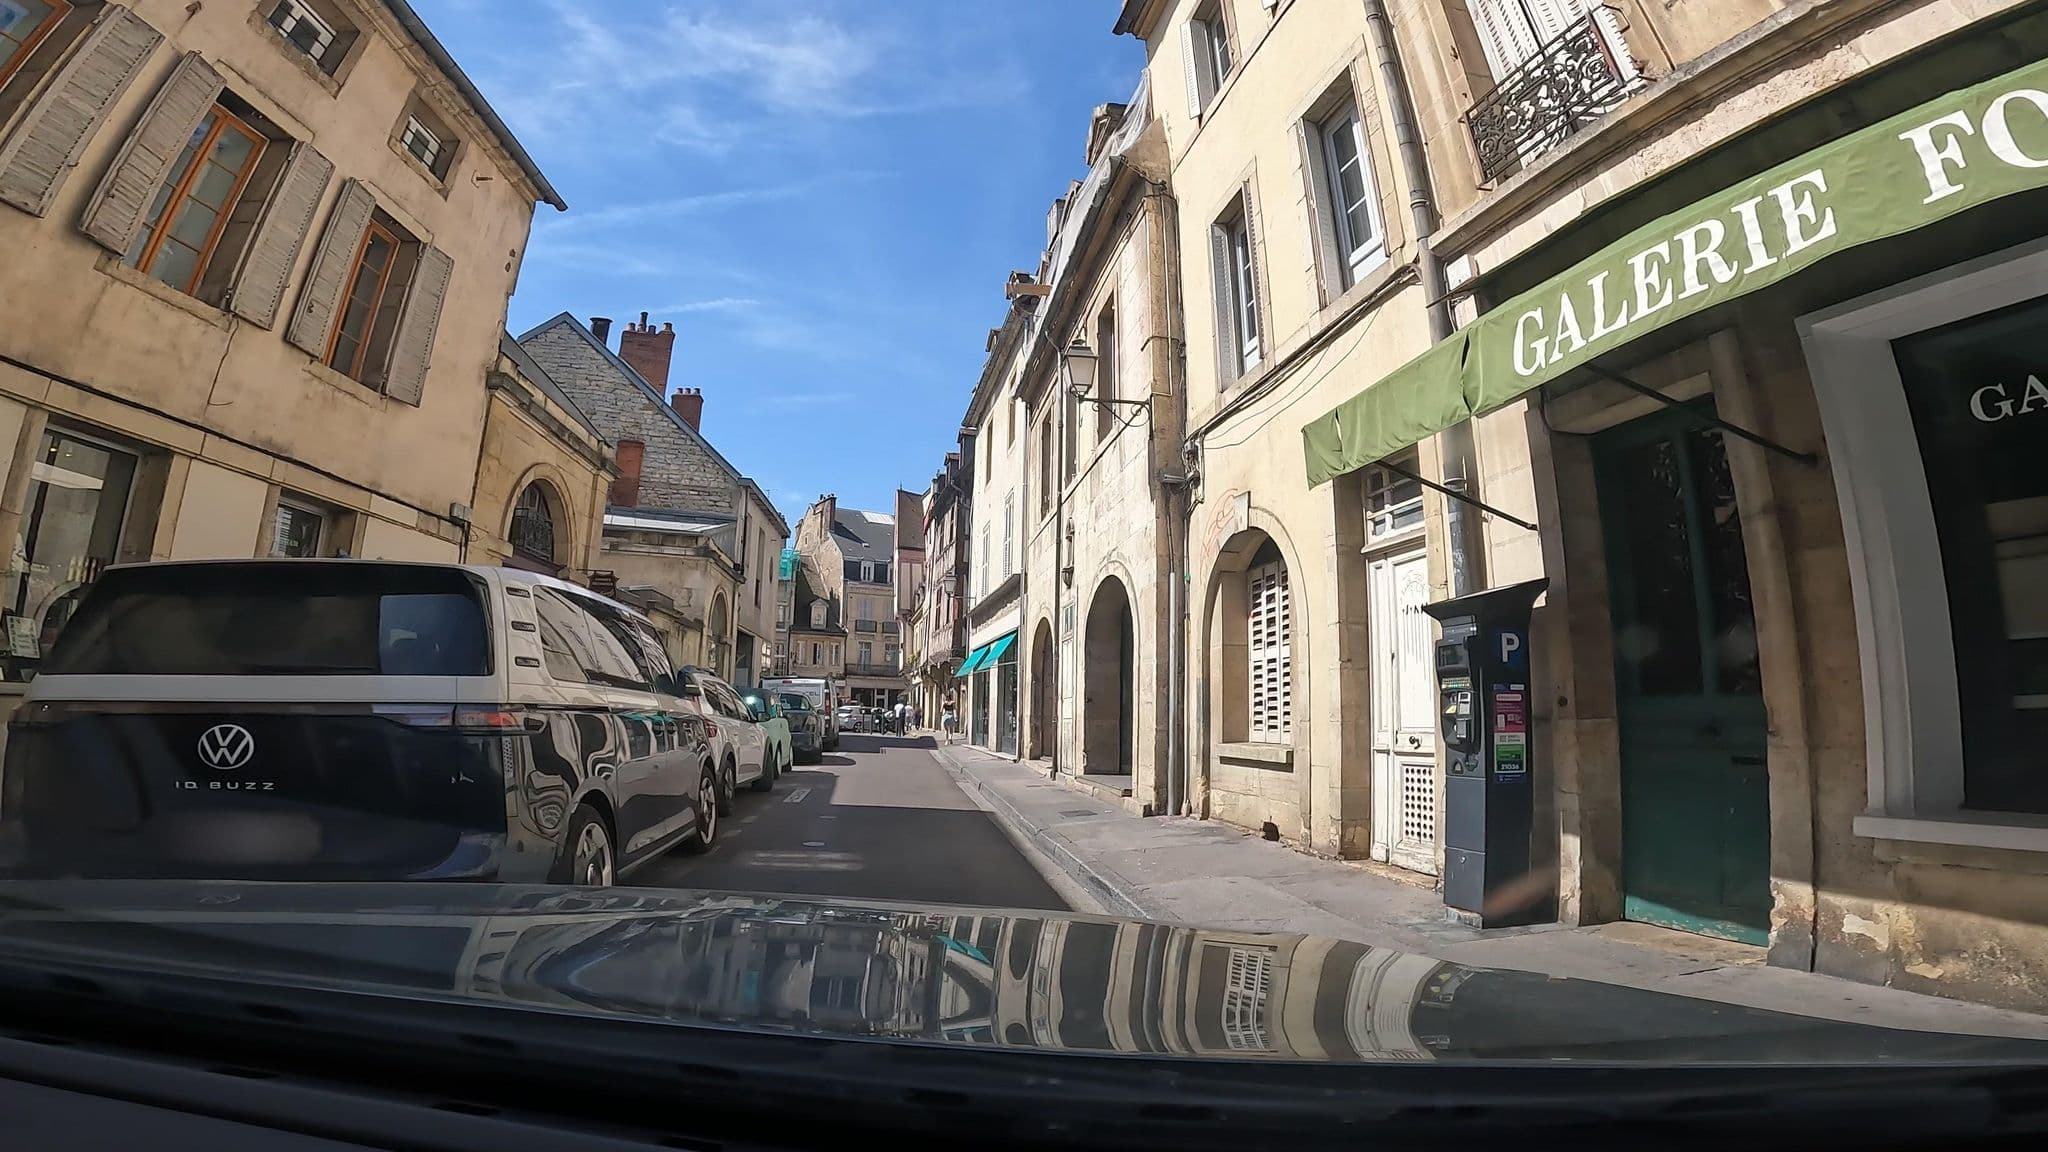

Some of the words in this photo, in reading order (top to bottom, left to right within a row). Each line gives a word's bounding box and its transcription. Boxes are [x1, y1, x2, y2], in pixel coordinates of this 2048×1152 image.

[1512, 168, 1837, 377] GALERIE
[1897, 88, 2048, 205] FO
[1970, 374, 2048, 421] GA
[1501, 632, 1520, 662] P
[209, 781, 274, 790] BUZZ
